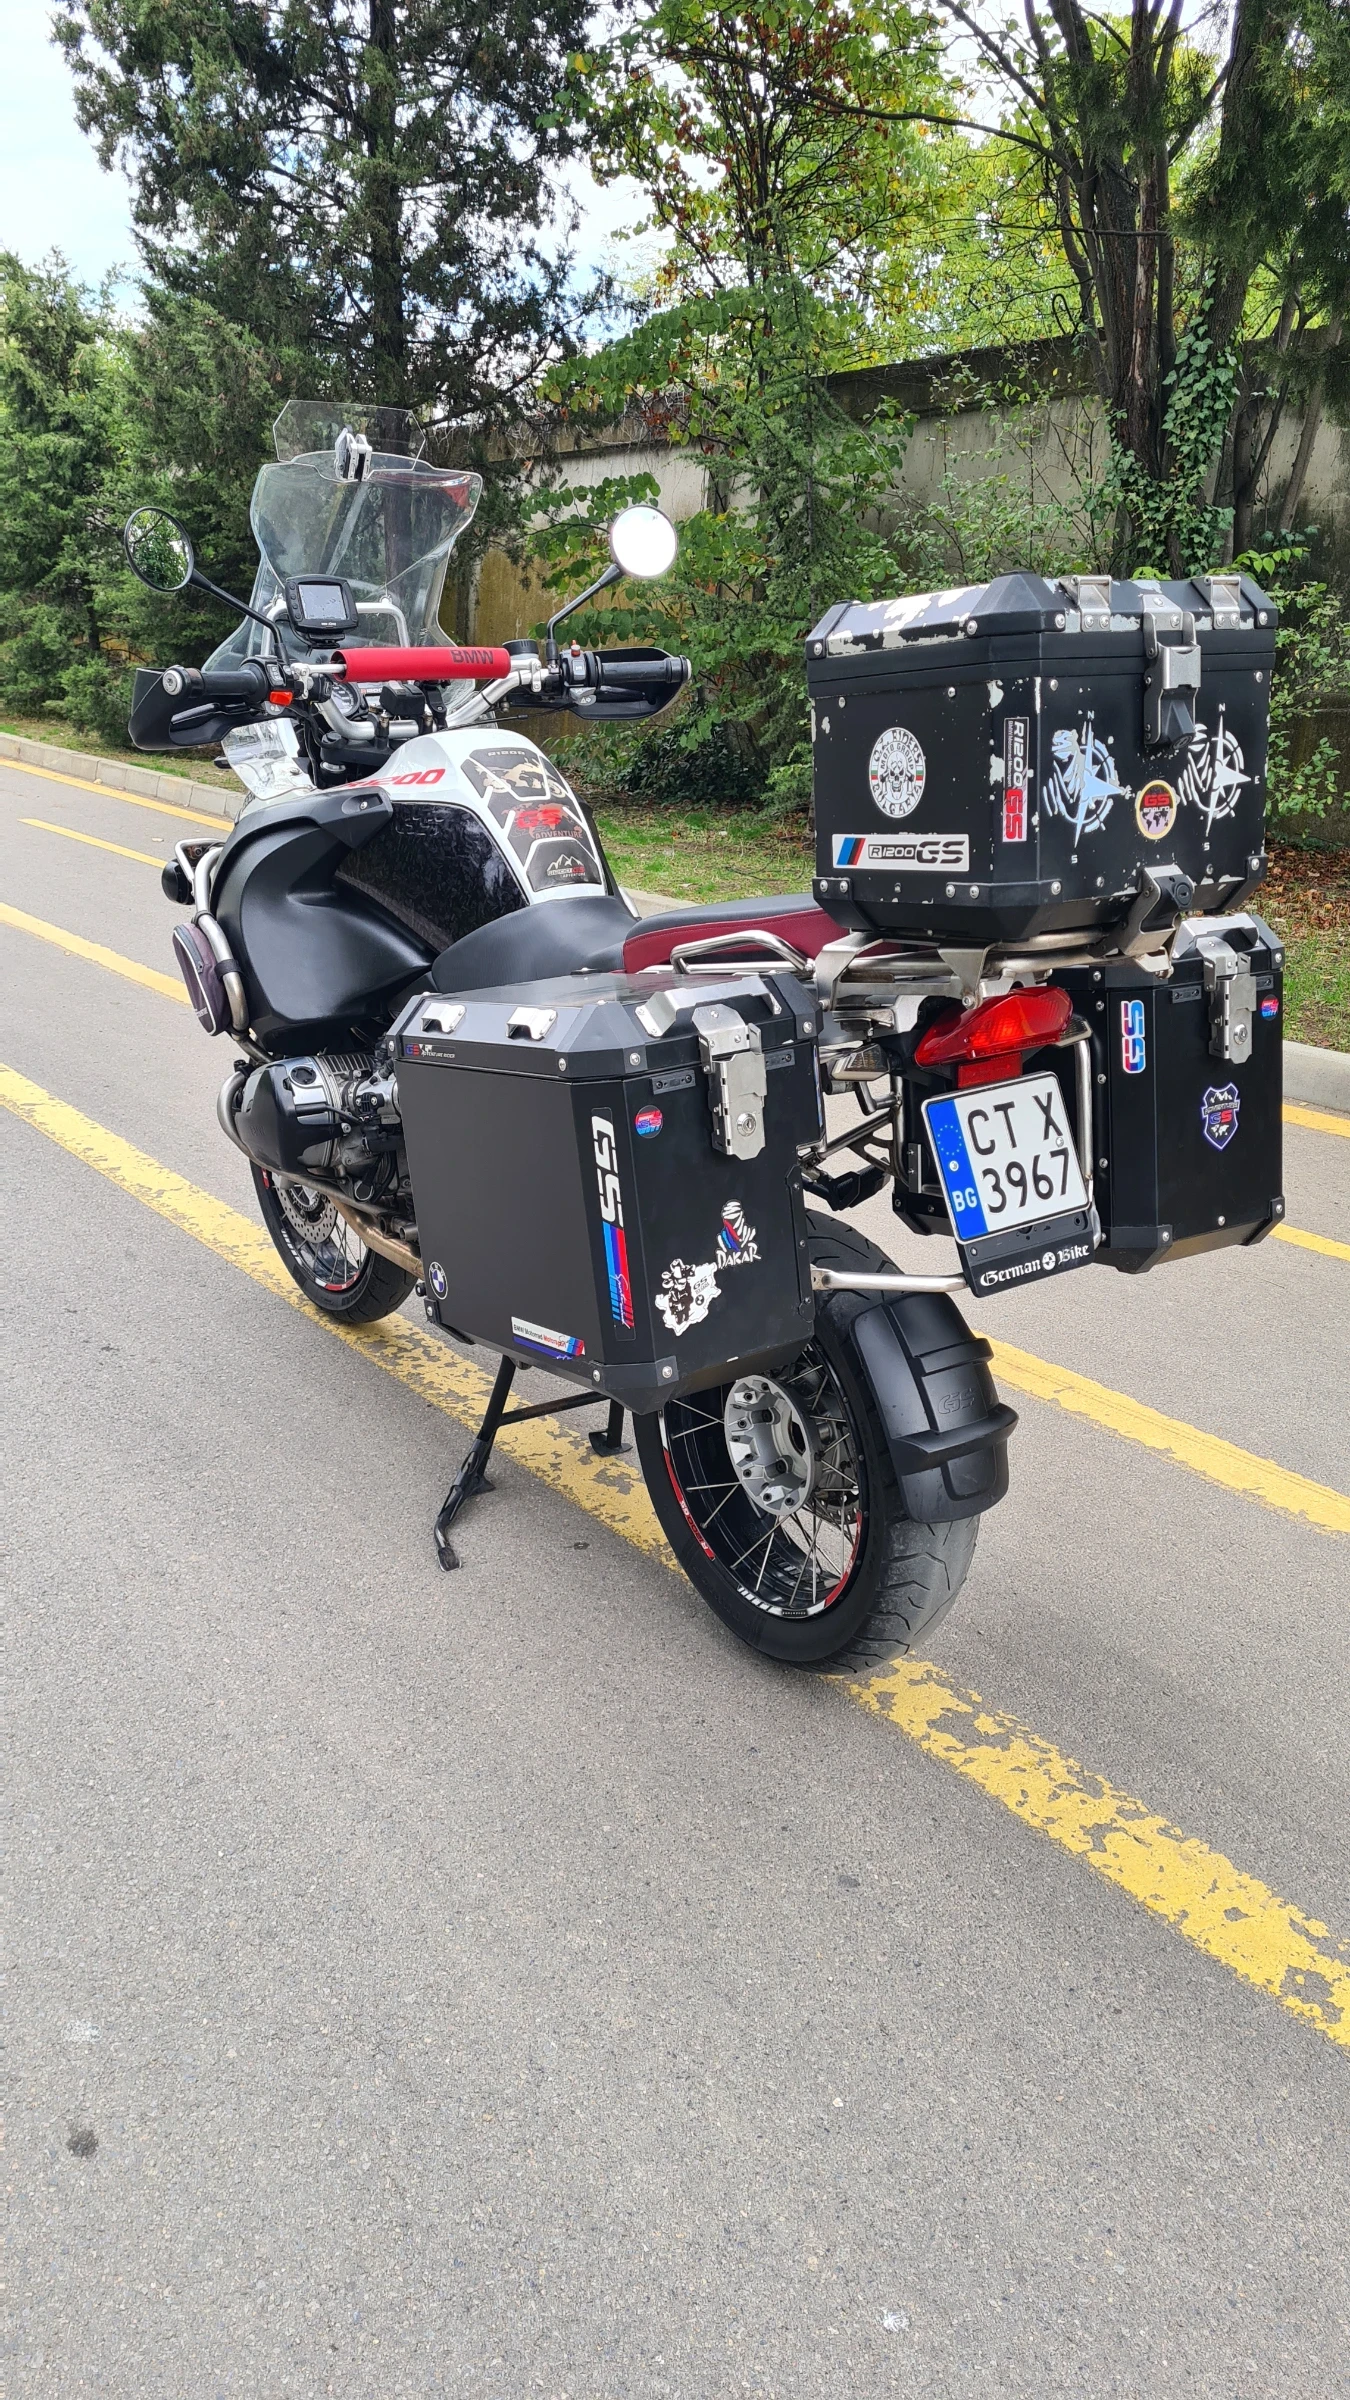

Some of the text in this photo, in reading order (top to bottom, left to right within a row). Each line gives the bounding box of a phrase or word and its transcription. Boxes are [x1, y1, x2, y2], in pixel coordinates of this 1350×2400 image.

[452, 650, 494, 664] BMW
[1087, 711, 1095, 719] N
[1219, 703, 1226, 711] N
[1006, 721, 1025, 840] R1200 GS
[1254, 775, 1260, 785] E
[1143, 794, 1170, 806] GS
[516, 808, 561, 829] GS
[535, 830, 583, 840] ADVENTURE
[870, 841, 965, 864] R1200 GS
[1204, 842, 1210, 851] S
[1071, 854, 1078, 864] S
[1121, 1000, 1146, 1074] GS
[967, 1091, 1064, 1155] CT X
[1210, 1109, 1232, 1124] GS
[591, 1115, 624, 1228] GS
[982, 1147, 1070, 1213] 3967
[952, 1187, 978, 1212] BG
[716, 1242, 762, 1269] DAKAR
[980, 1244, 1091, 1287] German Bike
[693, 1276, 708, 1290] GS
